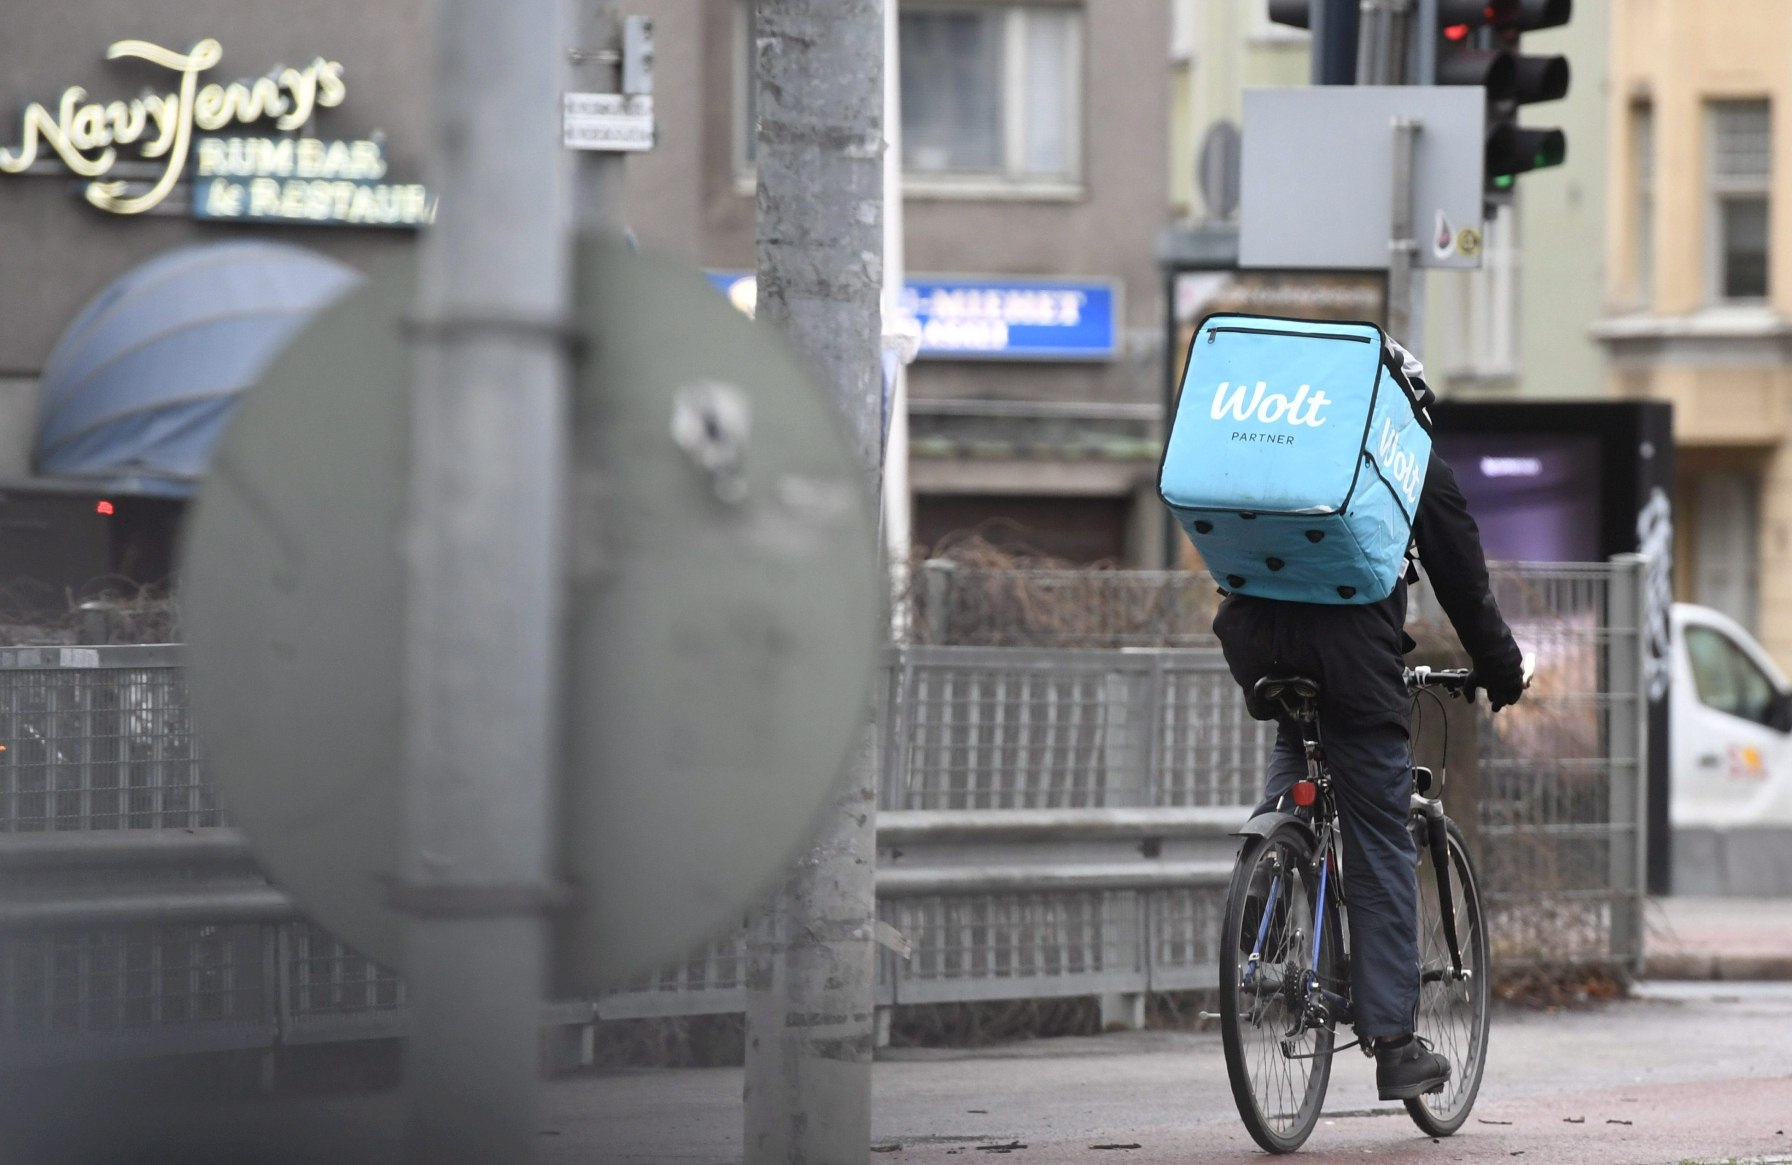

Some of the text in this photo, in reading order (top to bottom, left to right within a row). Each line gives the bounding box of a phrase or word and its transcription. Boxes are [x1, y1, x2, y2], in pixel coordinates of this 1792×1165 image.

[0, 86, 178, 176] Navy
[199, 137, 386, 179] RUM BAR
[249, 178, 438, 223] RESTAUR
[1210, 381, 1331, 427] Wolt
[1231, 432, 1294, 445] PARTNER
[1378, 417, 1419, 503] Wolt
